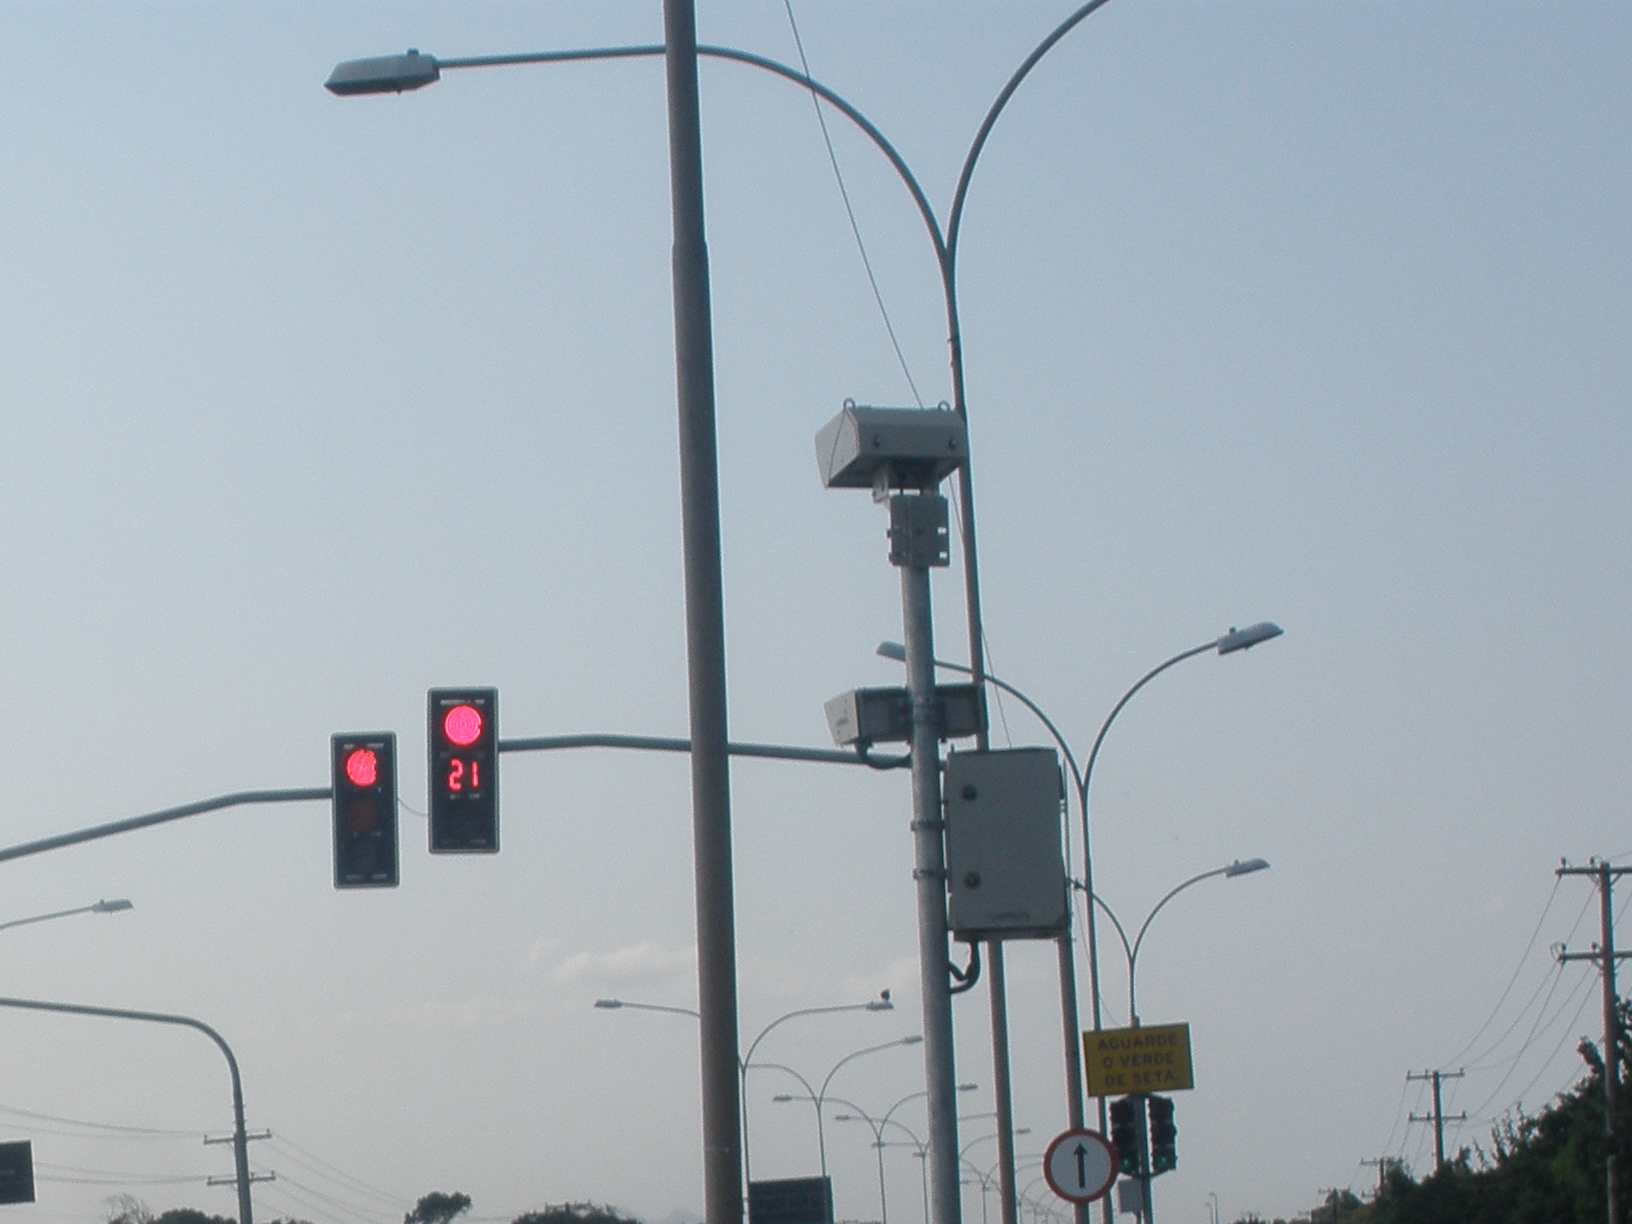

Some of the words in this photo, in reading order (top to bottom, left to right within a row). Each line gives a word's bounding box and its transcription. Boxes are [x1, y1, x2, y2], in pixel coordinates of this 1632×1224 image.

[449, 758, 479, 791] 21
[1098, 1033, 1176, 1050] AGUARDE
[1103, 1056, 1113, 1068] O
[1120, 1051, 1174, 1067] VERDE
[1104, 1073, 1125, 1086] DE
[1133, 1070, 1174, 1083] SETA
